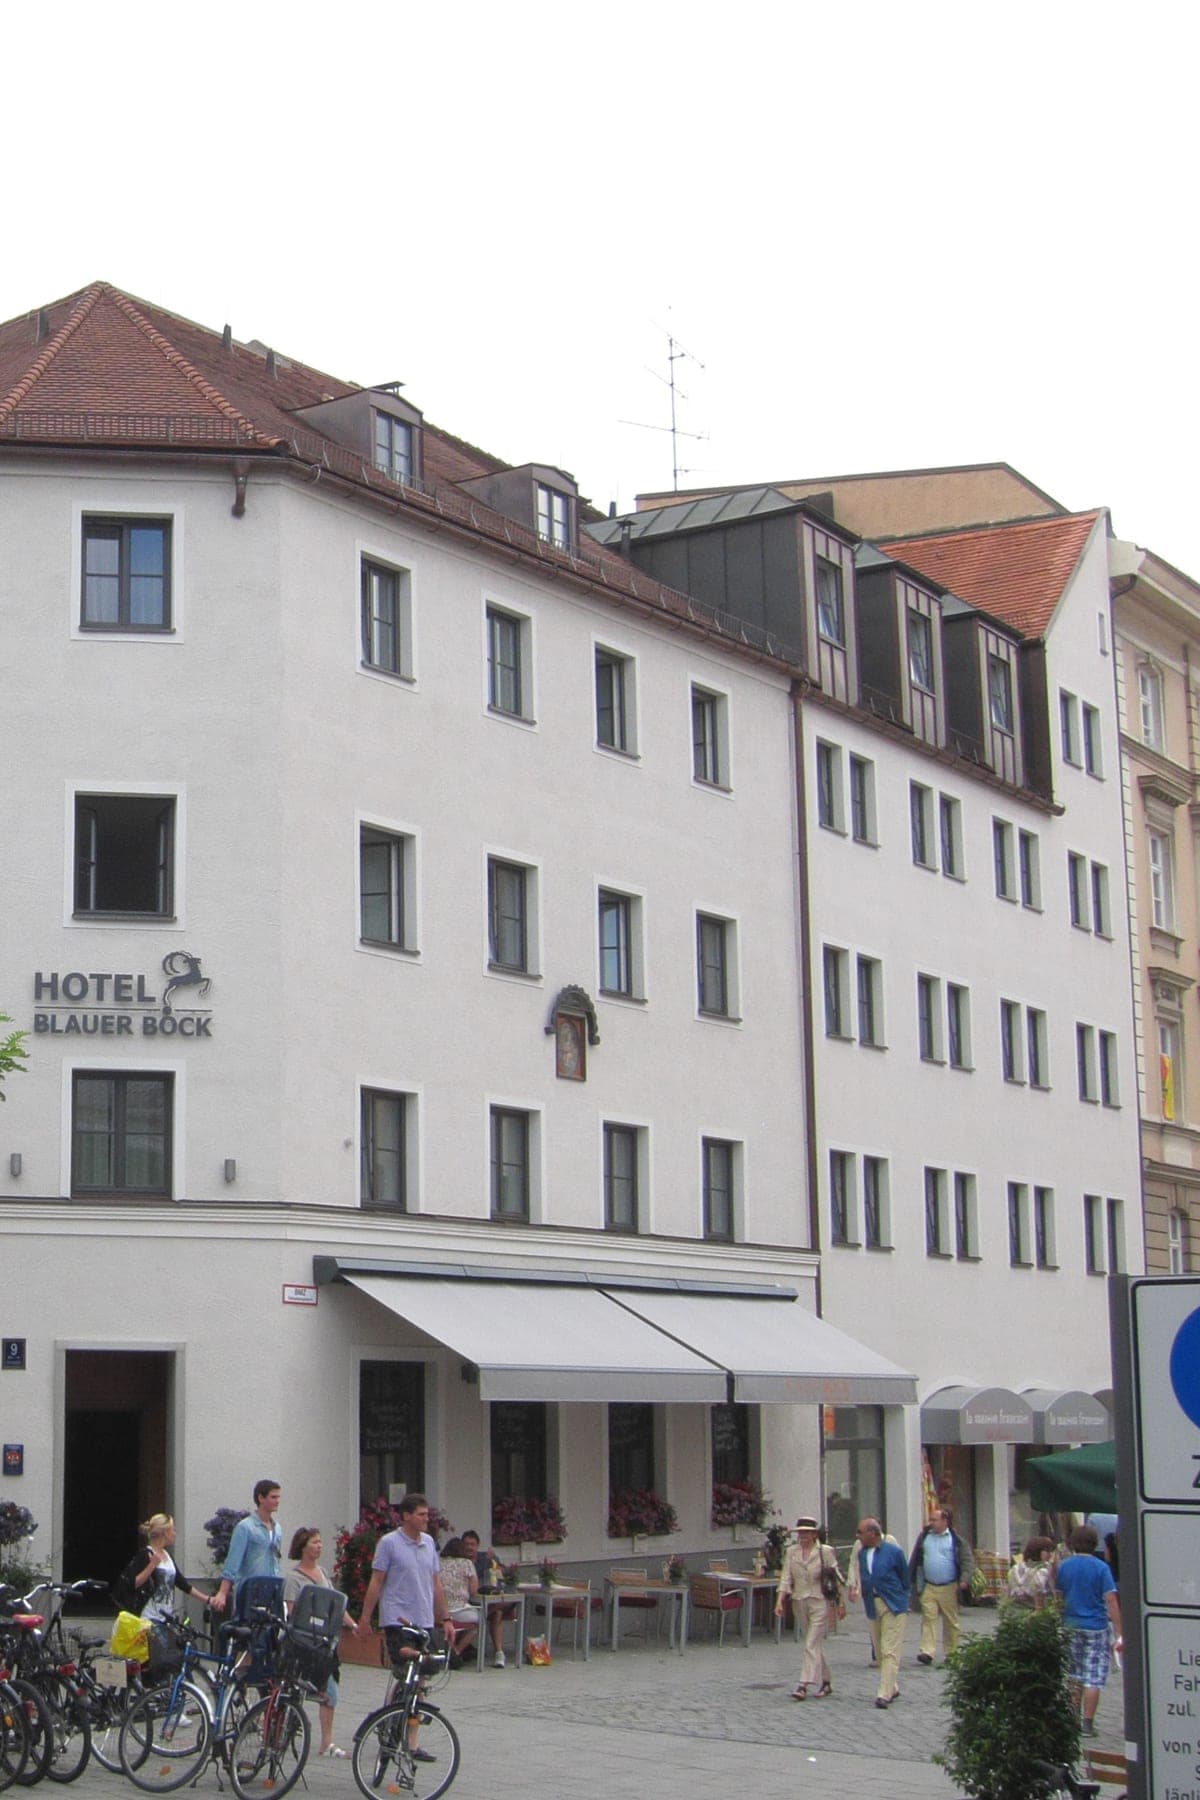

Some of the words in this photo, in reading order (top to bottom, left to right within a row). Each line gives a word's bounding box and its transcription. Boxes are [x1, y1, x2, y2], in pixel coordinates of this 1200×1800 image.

[34, 972, 156, 1002] HOTEL
[34, 1013, 134, 1035] BLAUER
[142, 1015, 213, 1037] BOCK
[10, 1343, 18, 1356] 9
[1167, 1700, 1196, 1718] zul.
[1162, 1740, 1191, 1754] von
